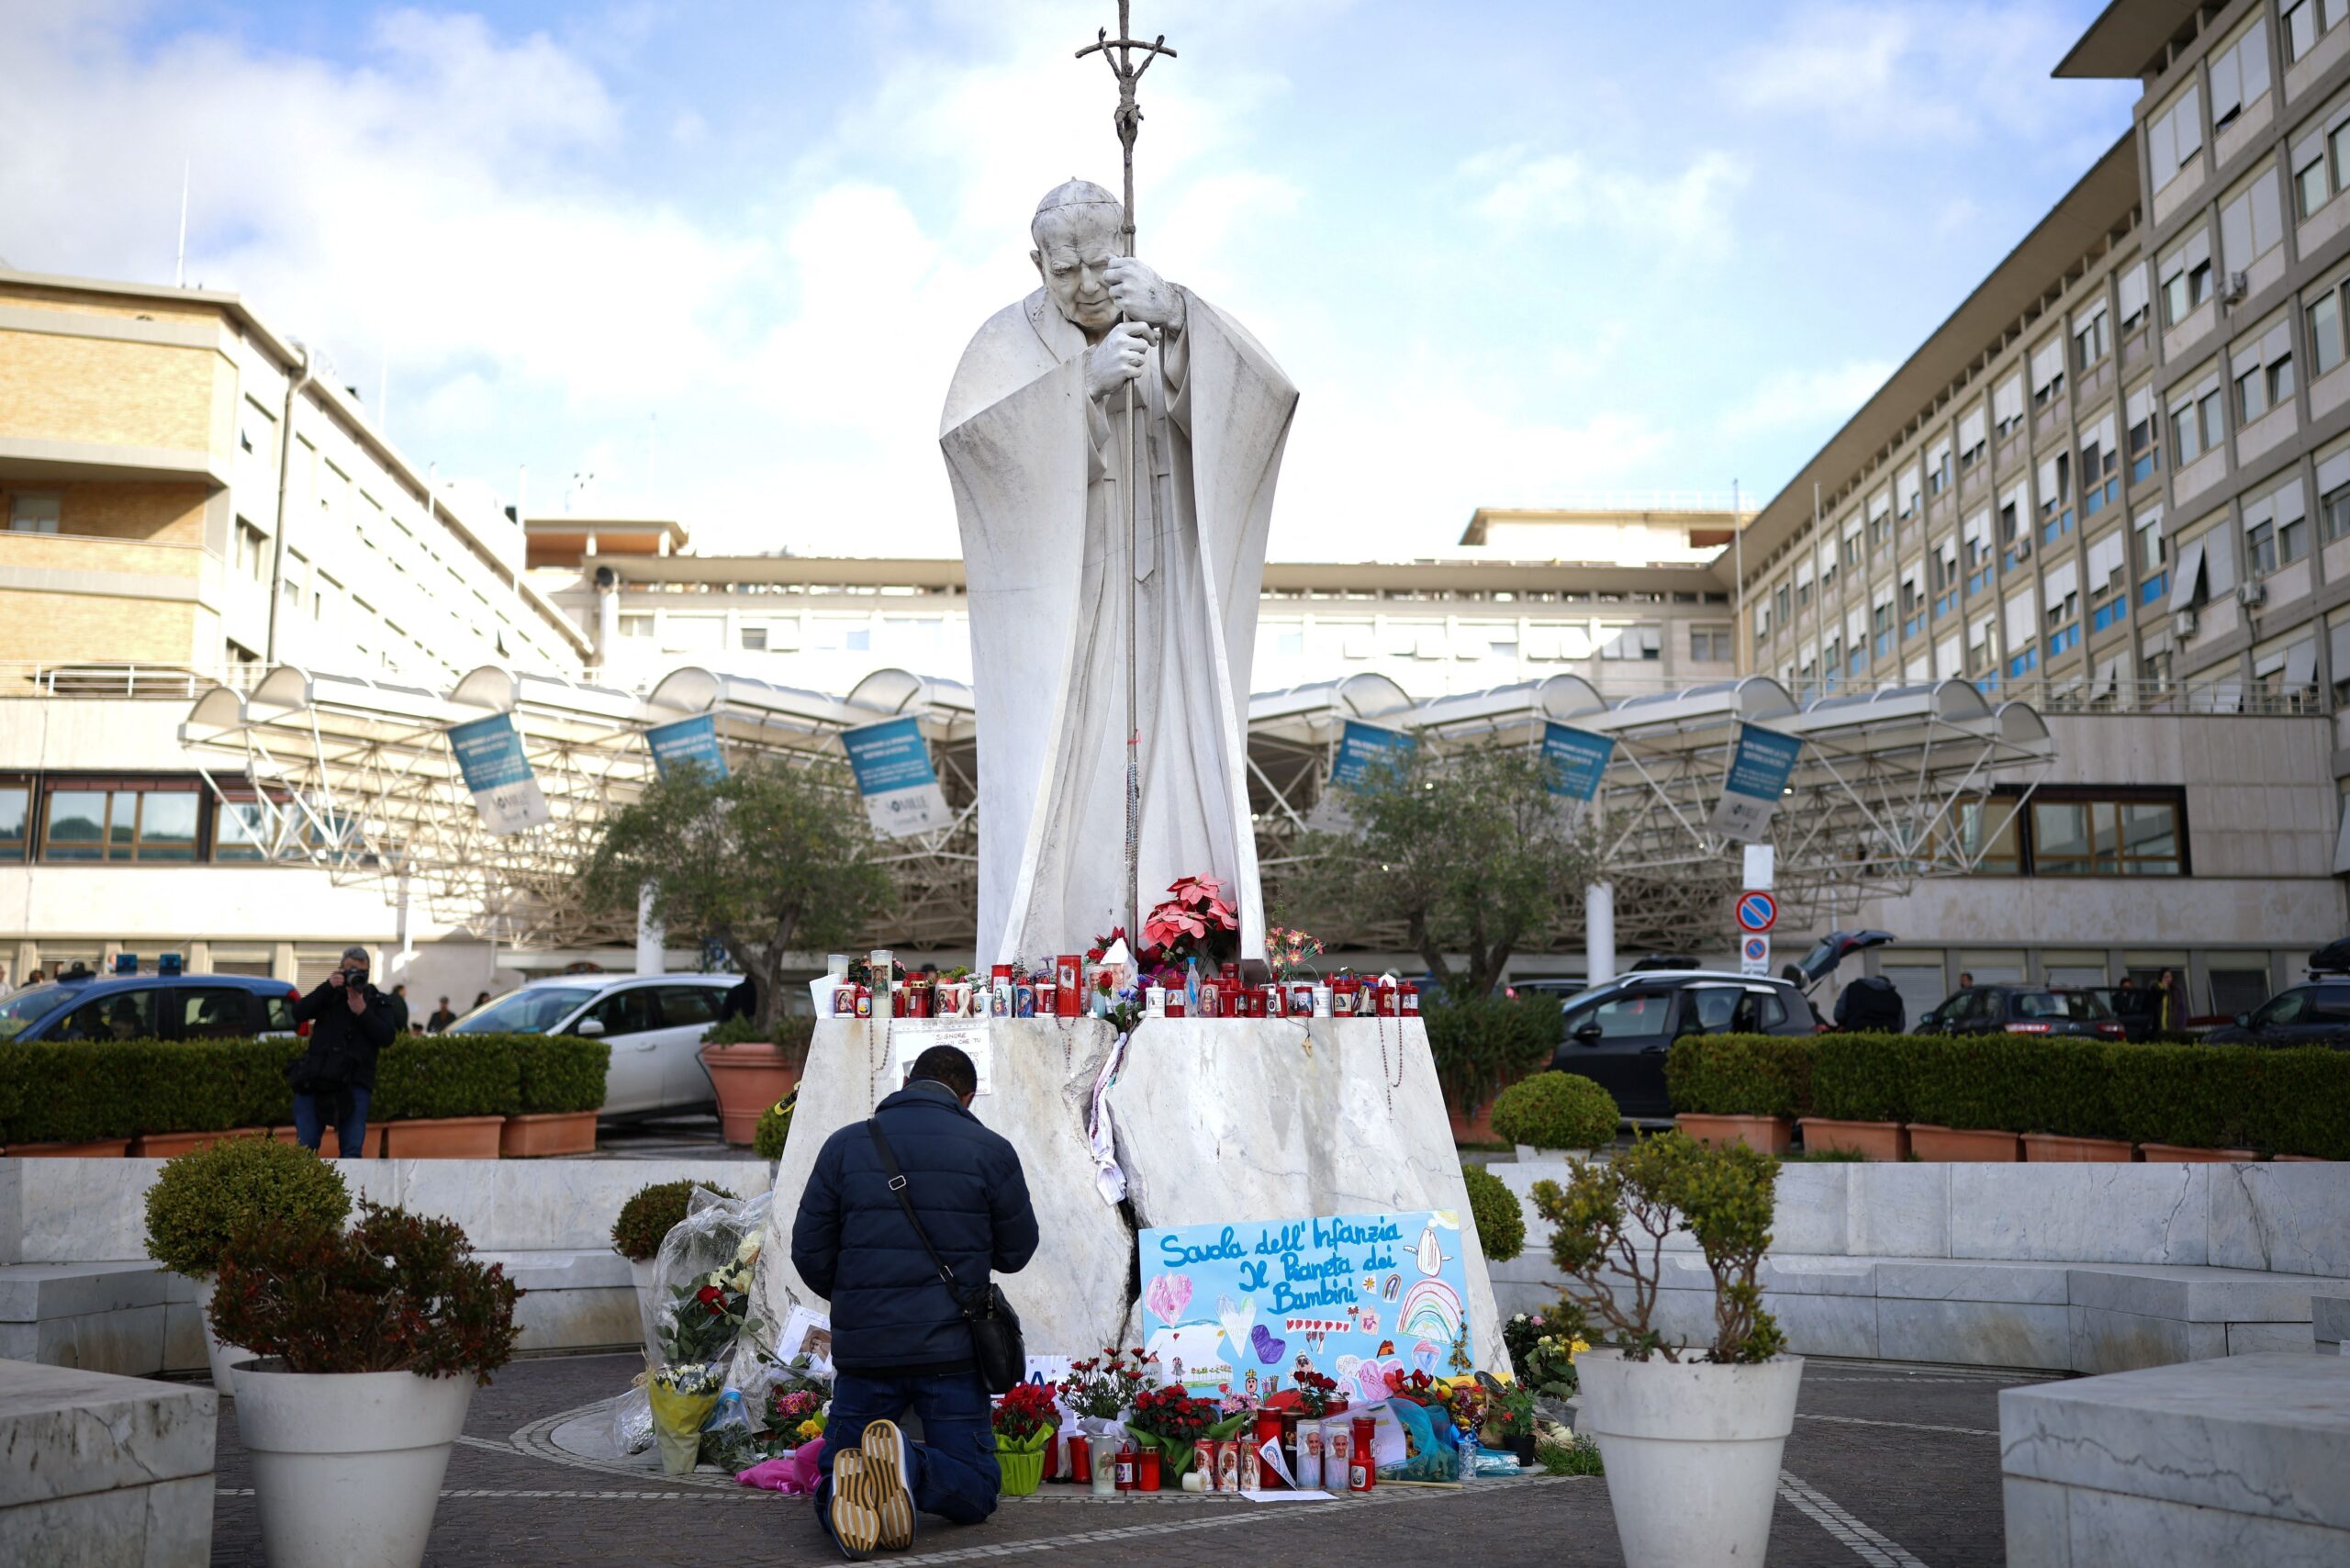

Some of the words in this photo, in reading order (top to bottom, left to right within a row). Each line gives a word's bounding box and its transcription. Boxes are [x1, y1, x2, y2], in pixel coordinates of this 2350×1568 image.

[1313, 1215, 1404, 1253] Infanzia
[1239, 1260, 1270, 1292] Il
[1281, 1251, 1356, 1282] Pianeta
[1362, 1244, 1398, 1271] dei
[1267, 1277, 1359, 1315] Bambini
